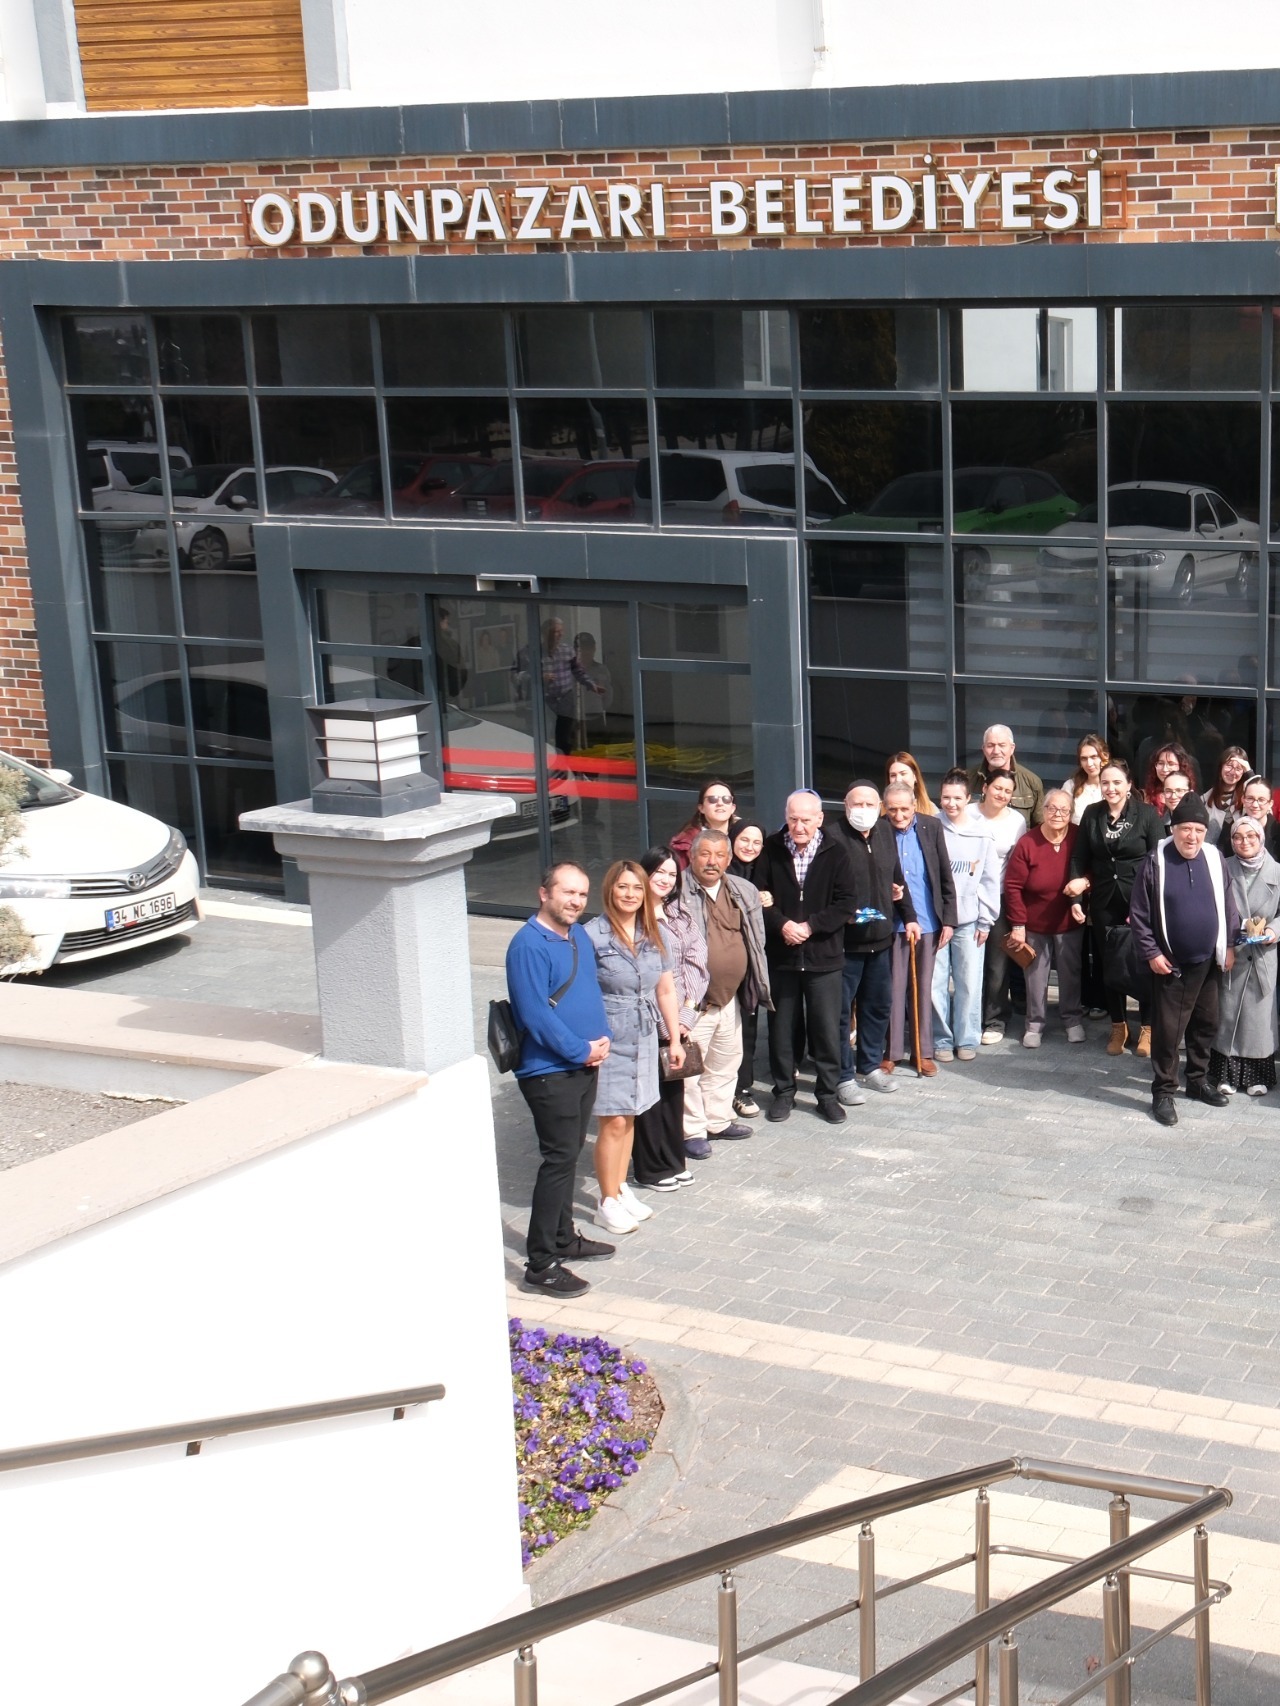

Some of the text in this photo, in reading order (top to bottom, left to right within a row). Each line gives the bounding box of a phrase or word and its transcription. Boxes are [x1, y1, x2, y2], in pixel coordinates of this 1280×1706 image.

[250, 182, 666, 246] ODUNPAZARI
[709, 148, 1102, 235] BELEDİYESİ
[114, 910, 127, 924] 34
[149, 897, 172, 914] 1696
